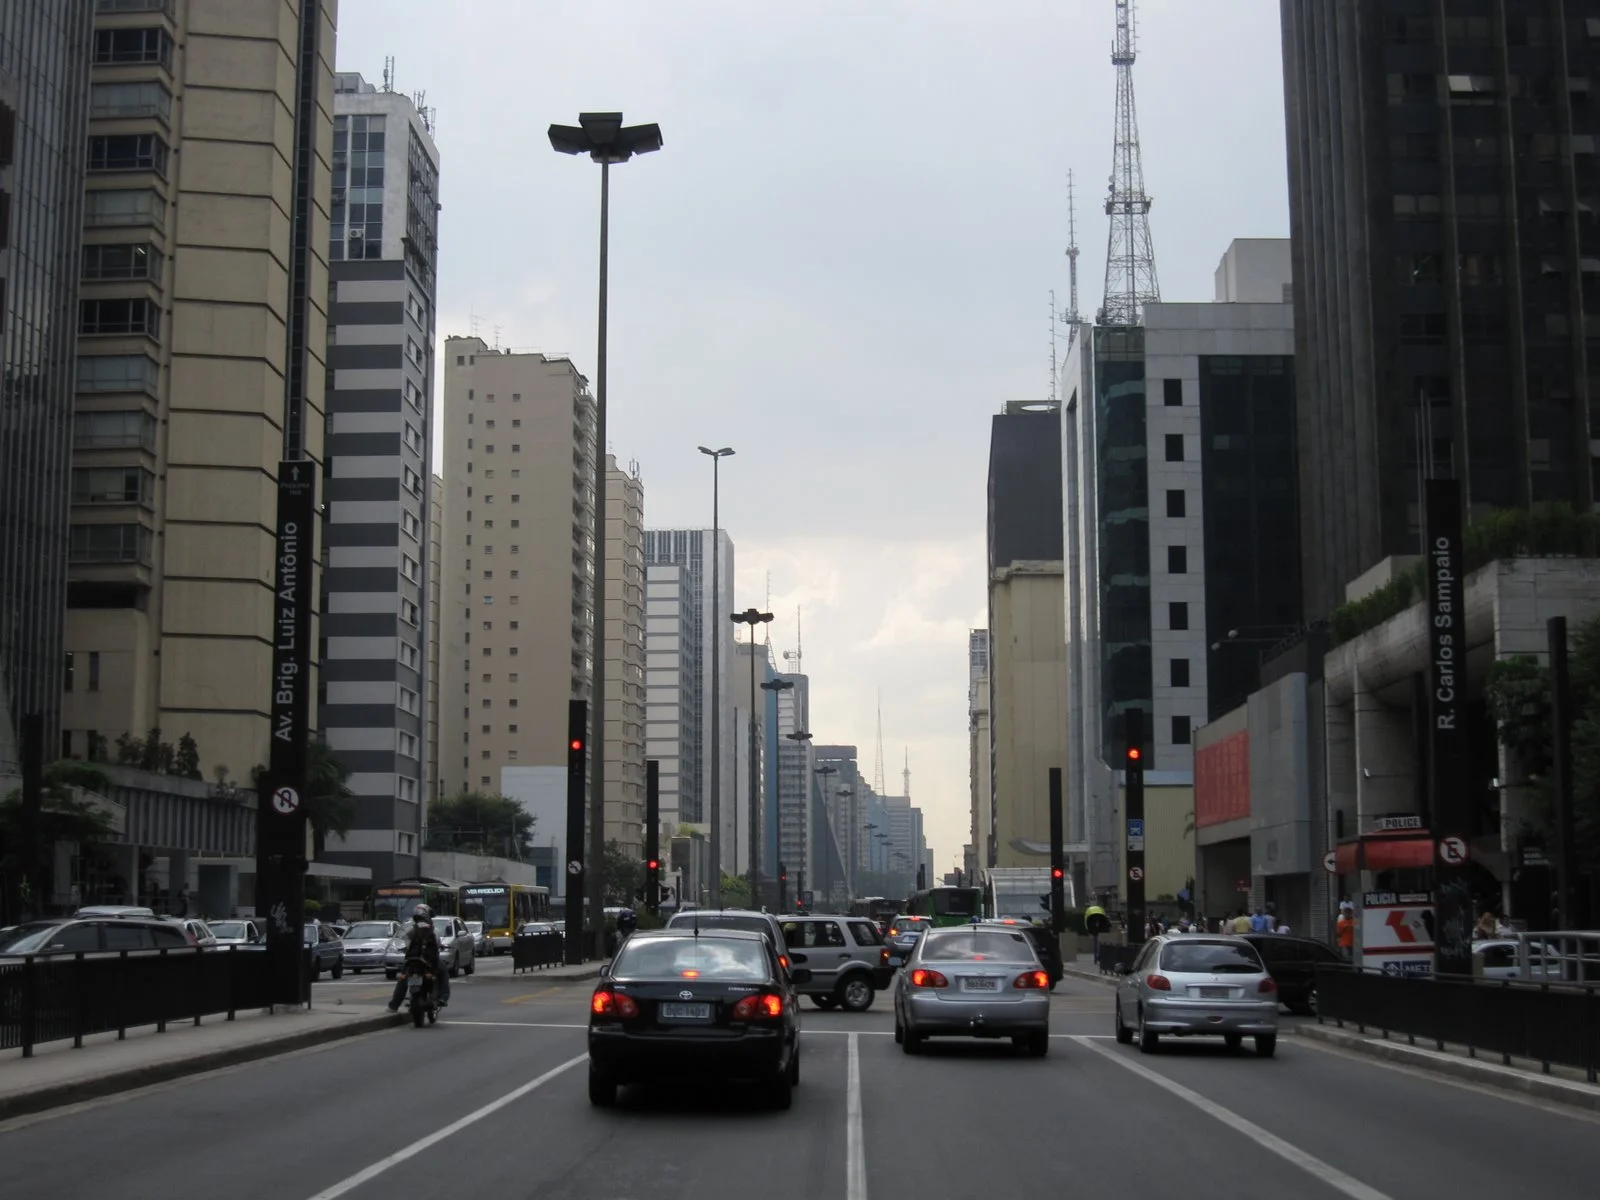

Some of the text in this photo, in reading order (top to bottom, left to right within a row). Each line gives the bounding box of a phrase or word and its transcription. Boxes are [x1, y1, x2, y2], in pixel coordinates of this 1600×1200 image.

[275, 521, 298, 742] Av. Brig. Luiz Antônio
[1432, 537, 1456, 730] R. Carlos Sampaio
[1385, 817, 1420, 828] POLICE
